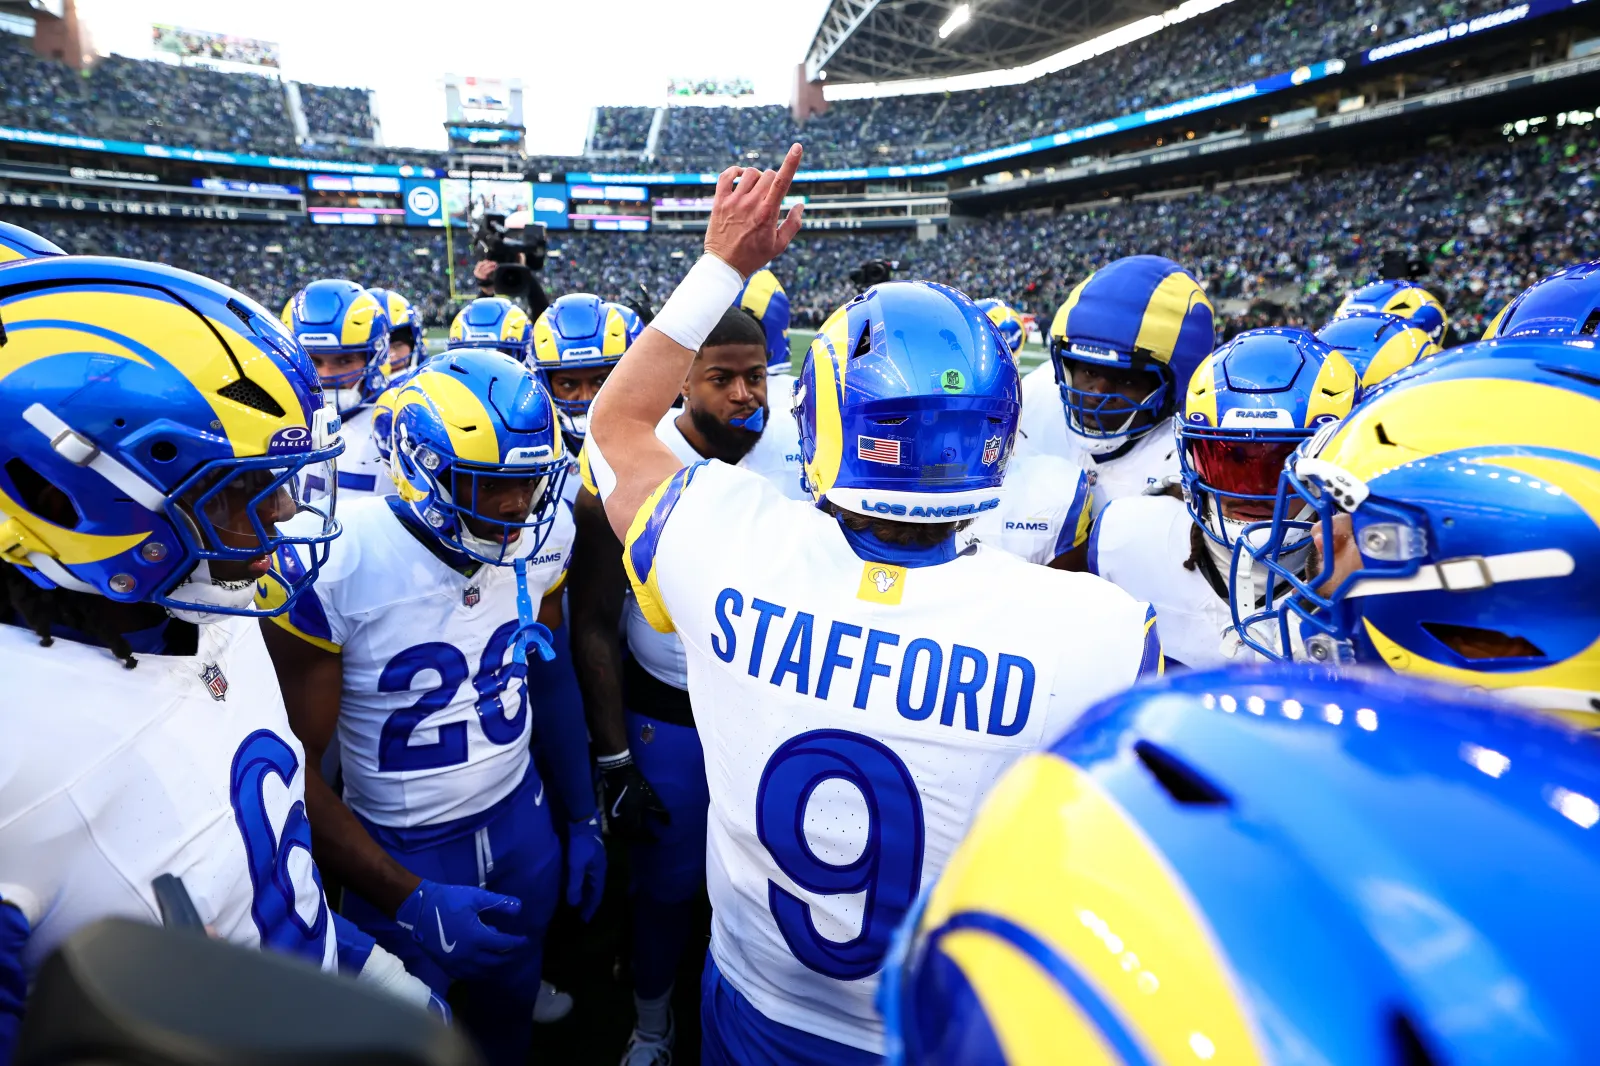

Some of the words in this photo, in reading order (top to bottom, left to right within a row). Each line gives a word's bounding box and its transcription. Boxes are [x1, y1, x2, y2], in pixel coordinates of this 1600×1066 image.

[1235, 410, 1278, 419] RAMS
[861, 499, 906, 516] LOS
[908, 497, 1000, 517] ANGELES
[1005, 521, 1049, 531] RAMS
[531, 552, 562, 566] RAMS
[711, 588, 1036, 737] STAFFORD
[756, 728, 925, 981] 9
